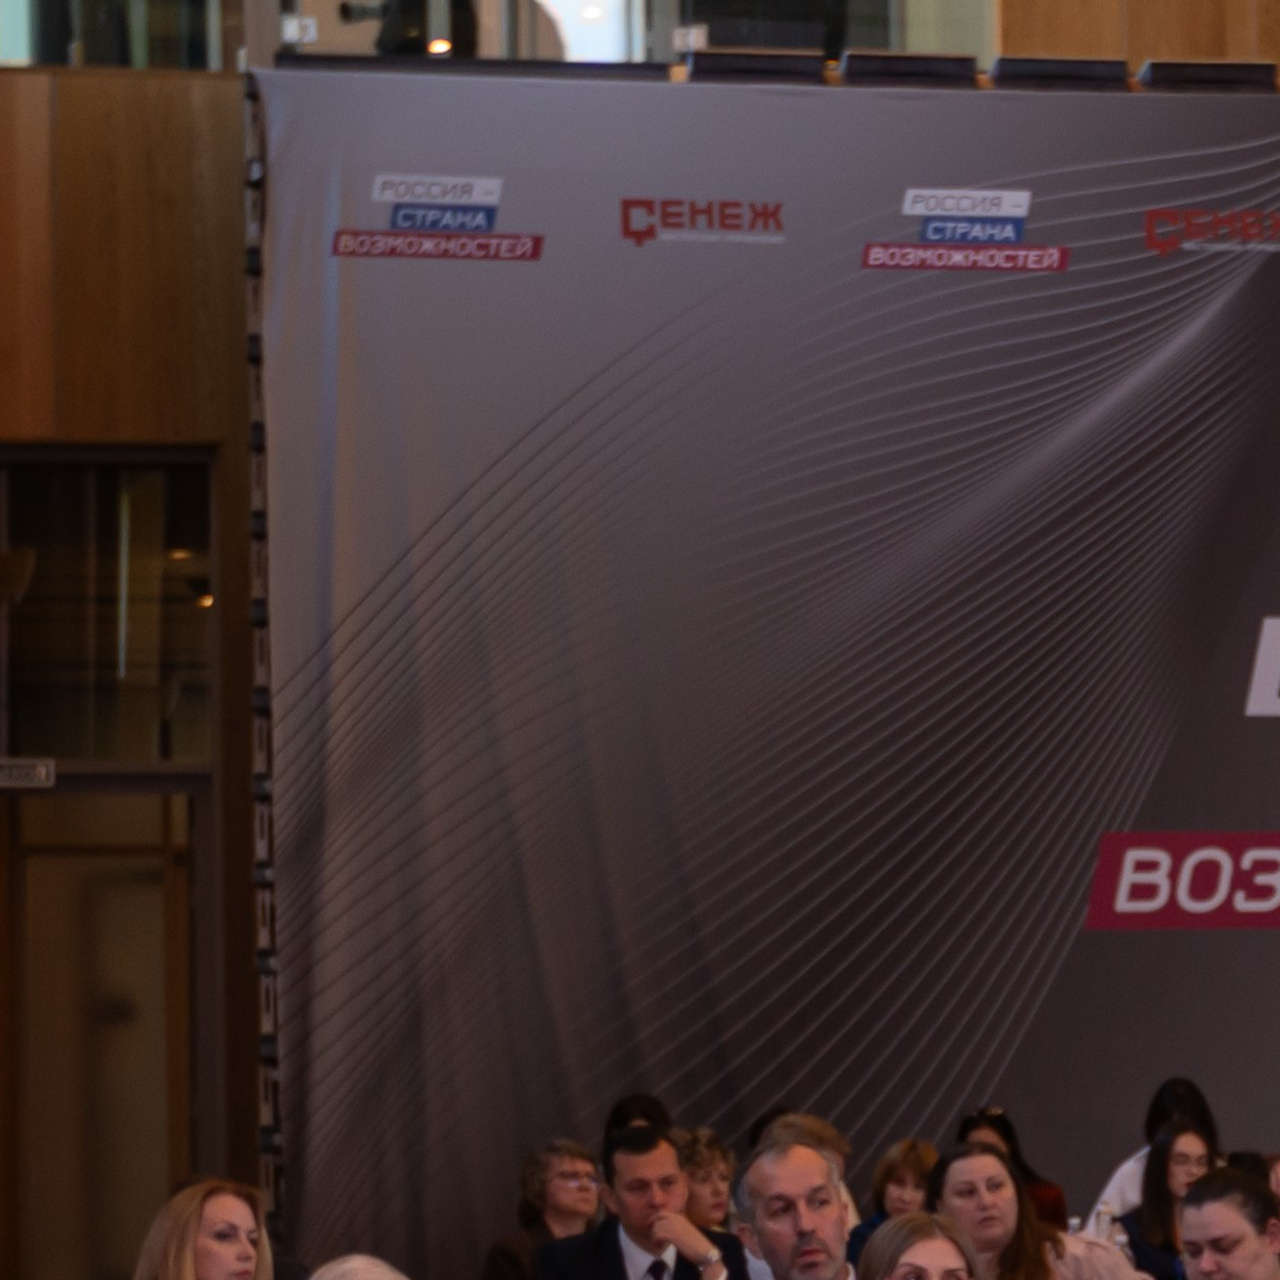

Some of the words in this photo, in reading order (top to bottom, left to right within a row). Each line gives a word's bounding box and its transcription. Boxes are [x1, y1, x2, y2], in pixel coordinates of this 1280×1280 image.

[380, 180, 474, 199] РОССИЯ
[910, 194, 1004, 213] РОССИЯ
[396, 207, 489, 229] СТРАНА
[621, 198, 784, 247] СЕНЕЖ
[926, 222, 1017, 242] СТРАНА
[338, 234, 534, 259] ВОЗМОЖНОСТЕЙ
[868, 247, 1061, 269] ВОЗМОЖНОСТЕЙ
